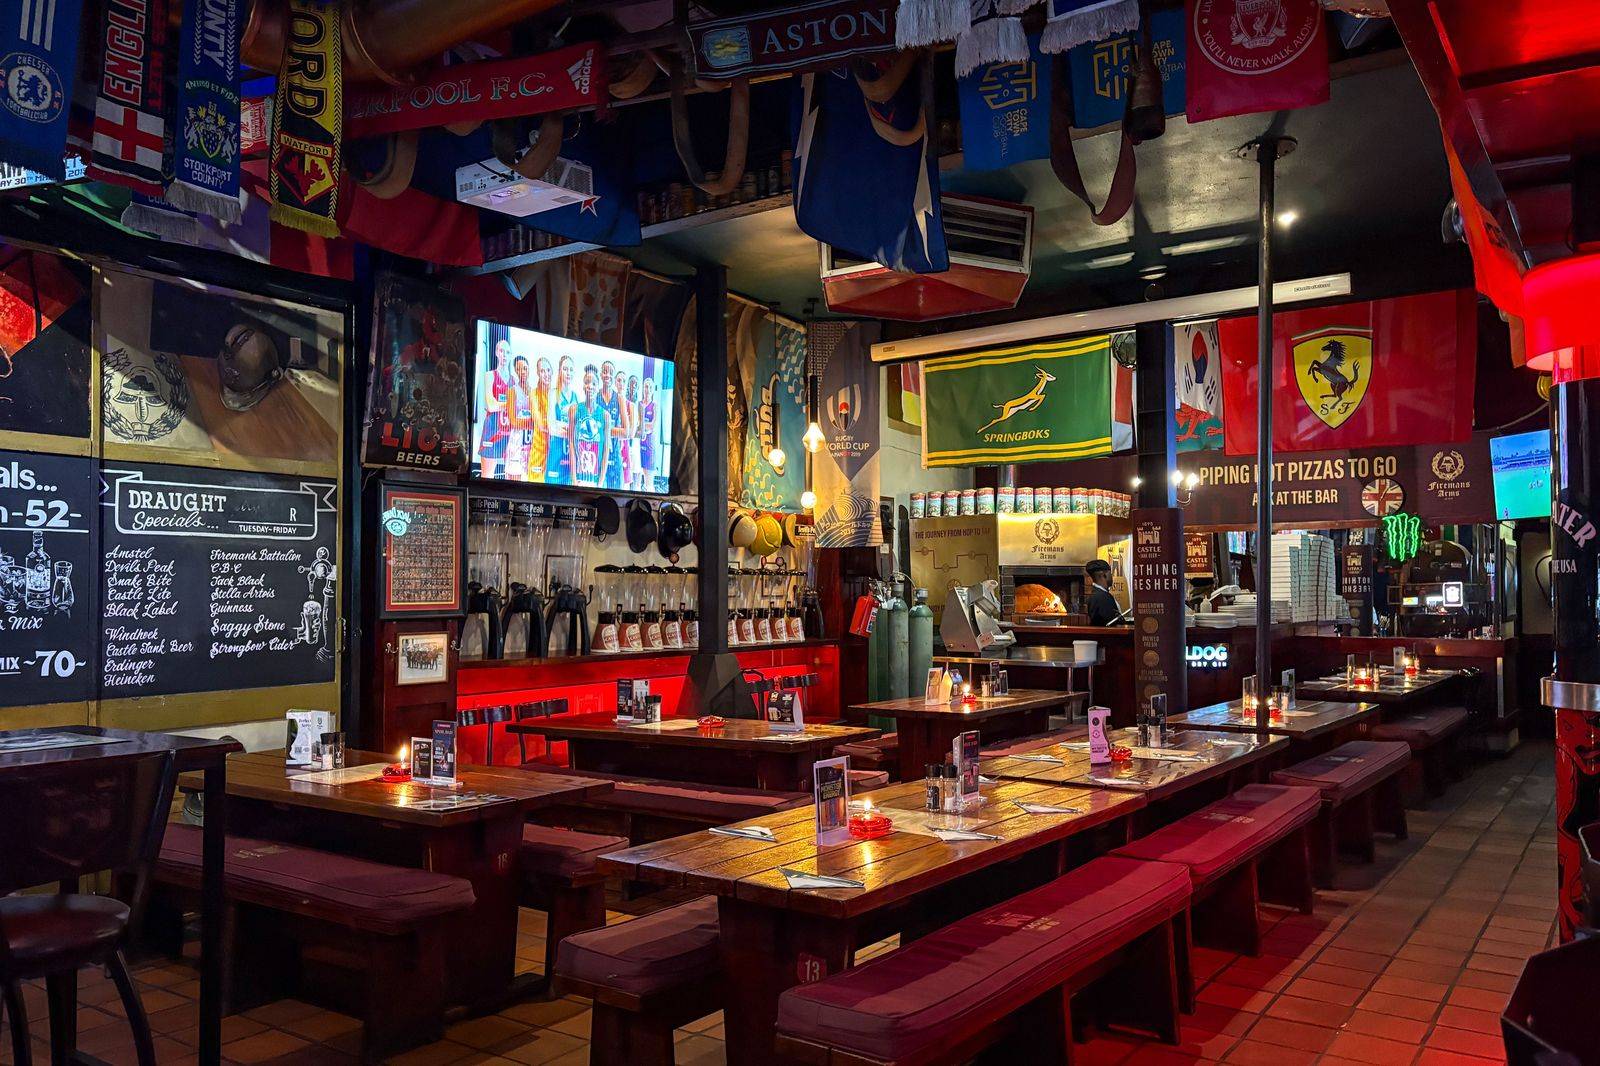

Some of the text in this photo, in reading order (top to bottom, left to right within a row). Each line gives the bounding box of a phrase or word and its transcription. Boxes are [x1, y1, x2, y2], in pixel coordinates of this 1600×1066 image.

[762, 8, 888, 54] ASTON
[1152, 48, 1175, 57] OWN
[1153, 40, 1172, 49] APE
[286, 0, 327, 117] ORD
[1227, 55, 1260, 68] NEVER
[1261, 46, 1294, 65] WALK
[16, 55, 53, 76] CHELSEA
[580, 49, 595, 95] adidas
[490, 73, 554, 101] F.C.
[283, 135, 329, 157] WATFORD
[183, 157, 233, 182] STOCKPORT
[191, 170, 225, 189] COUNTY
[984, 429, 1050, 443] SPRINGBOKS
[853, 442, 870, 450] CUP
[396, 451, 441, 466] BEERS
[1200, 464, 1250, 486] PIPING
[1288, 458, 1344, 482] PIZZAS
[1347, 457, 1369, 478] TO
[1373, 455, 1397, 477] GO
[1427, 480, 1471, 491] Firemans
[128, 489, 227, 513] DRAUGHT
[1275, 490, 1290, 506] AT
[1290, 489, 1312, 505] THE
[1314, 488, 1338, 504] BAR
[1437, 490, 1460, 498] Arms
[289, 507, 298, 522] R
[915, 531, 924, 539] THE
[925, 530, 947, 538] JOURNEY
[947, 528, 962, 537] FROM
[105, 545, 155, 559] Amstel
[258, 548, 302, 562] Battalion
[1031, 545, 1065, 553] Firemans
[1137, 545, 1162, 553] CASTLE
[142, 559, 176, 576] Peak
[1560, 559, 1578, 574] USA
[107, 572, 172, 588] Snake Bite
[210, 572, 265, 588] Jack Black
[108, 586, 172, 602] Castle Lite
[211, 586, 276, 602] Stella Artois
[104, 600, 178, 620] Black Label
[210, 600, 254, 614] Guinness
[8, 615, 43, 631] Mix
[211, 614, 286, 638] Saggy Stone
[105, 626, 159, 641] Windhoek
[106, 639, 195, 656] Castle Tank Beer
[210, 638, 297, 659] Strongbow Cider
[104, 658, 156, 675] Erdinger
[104, 674, 156, 687] Heineken
[804, 959, 821, 982] 13
